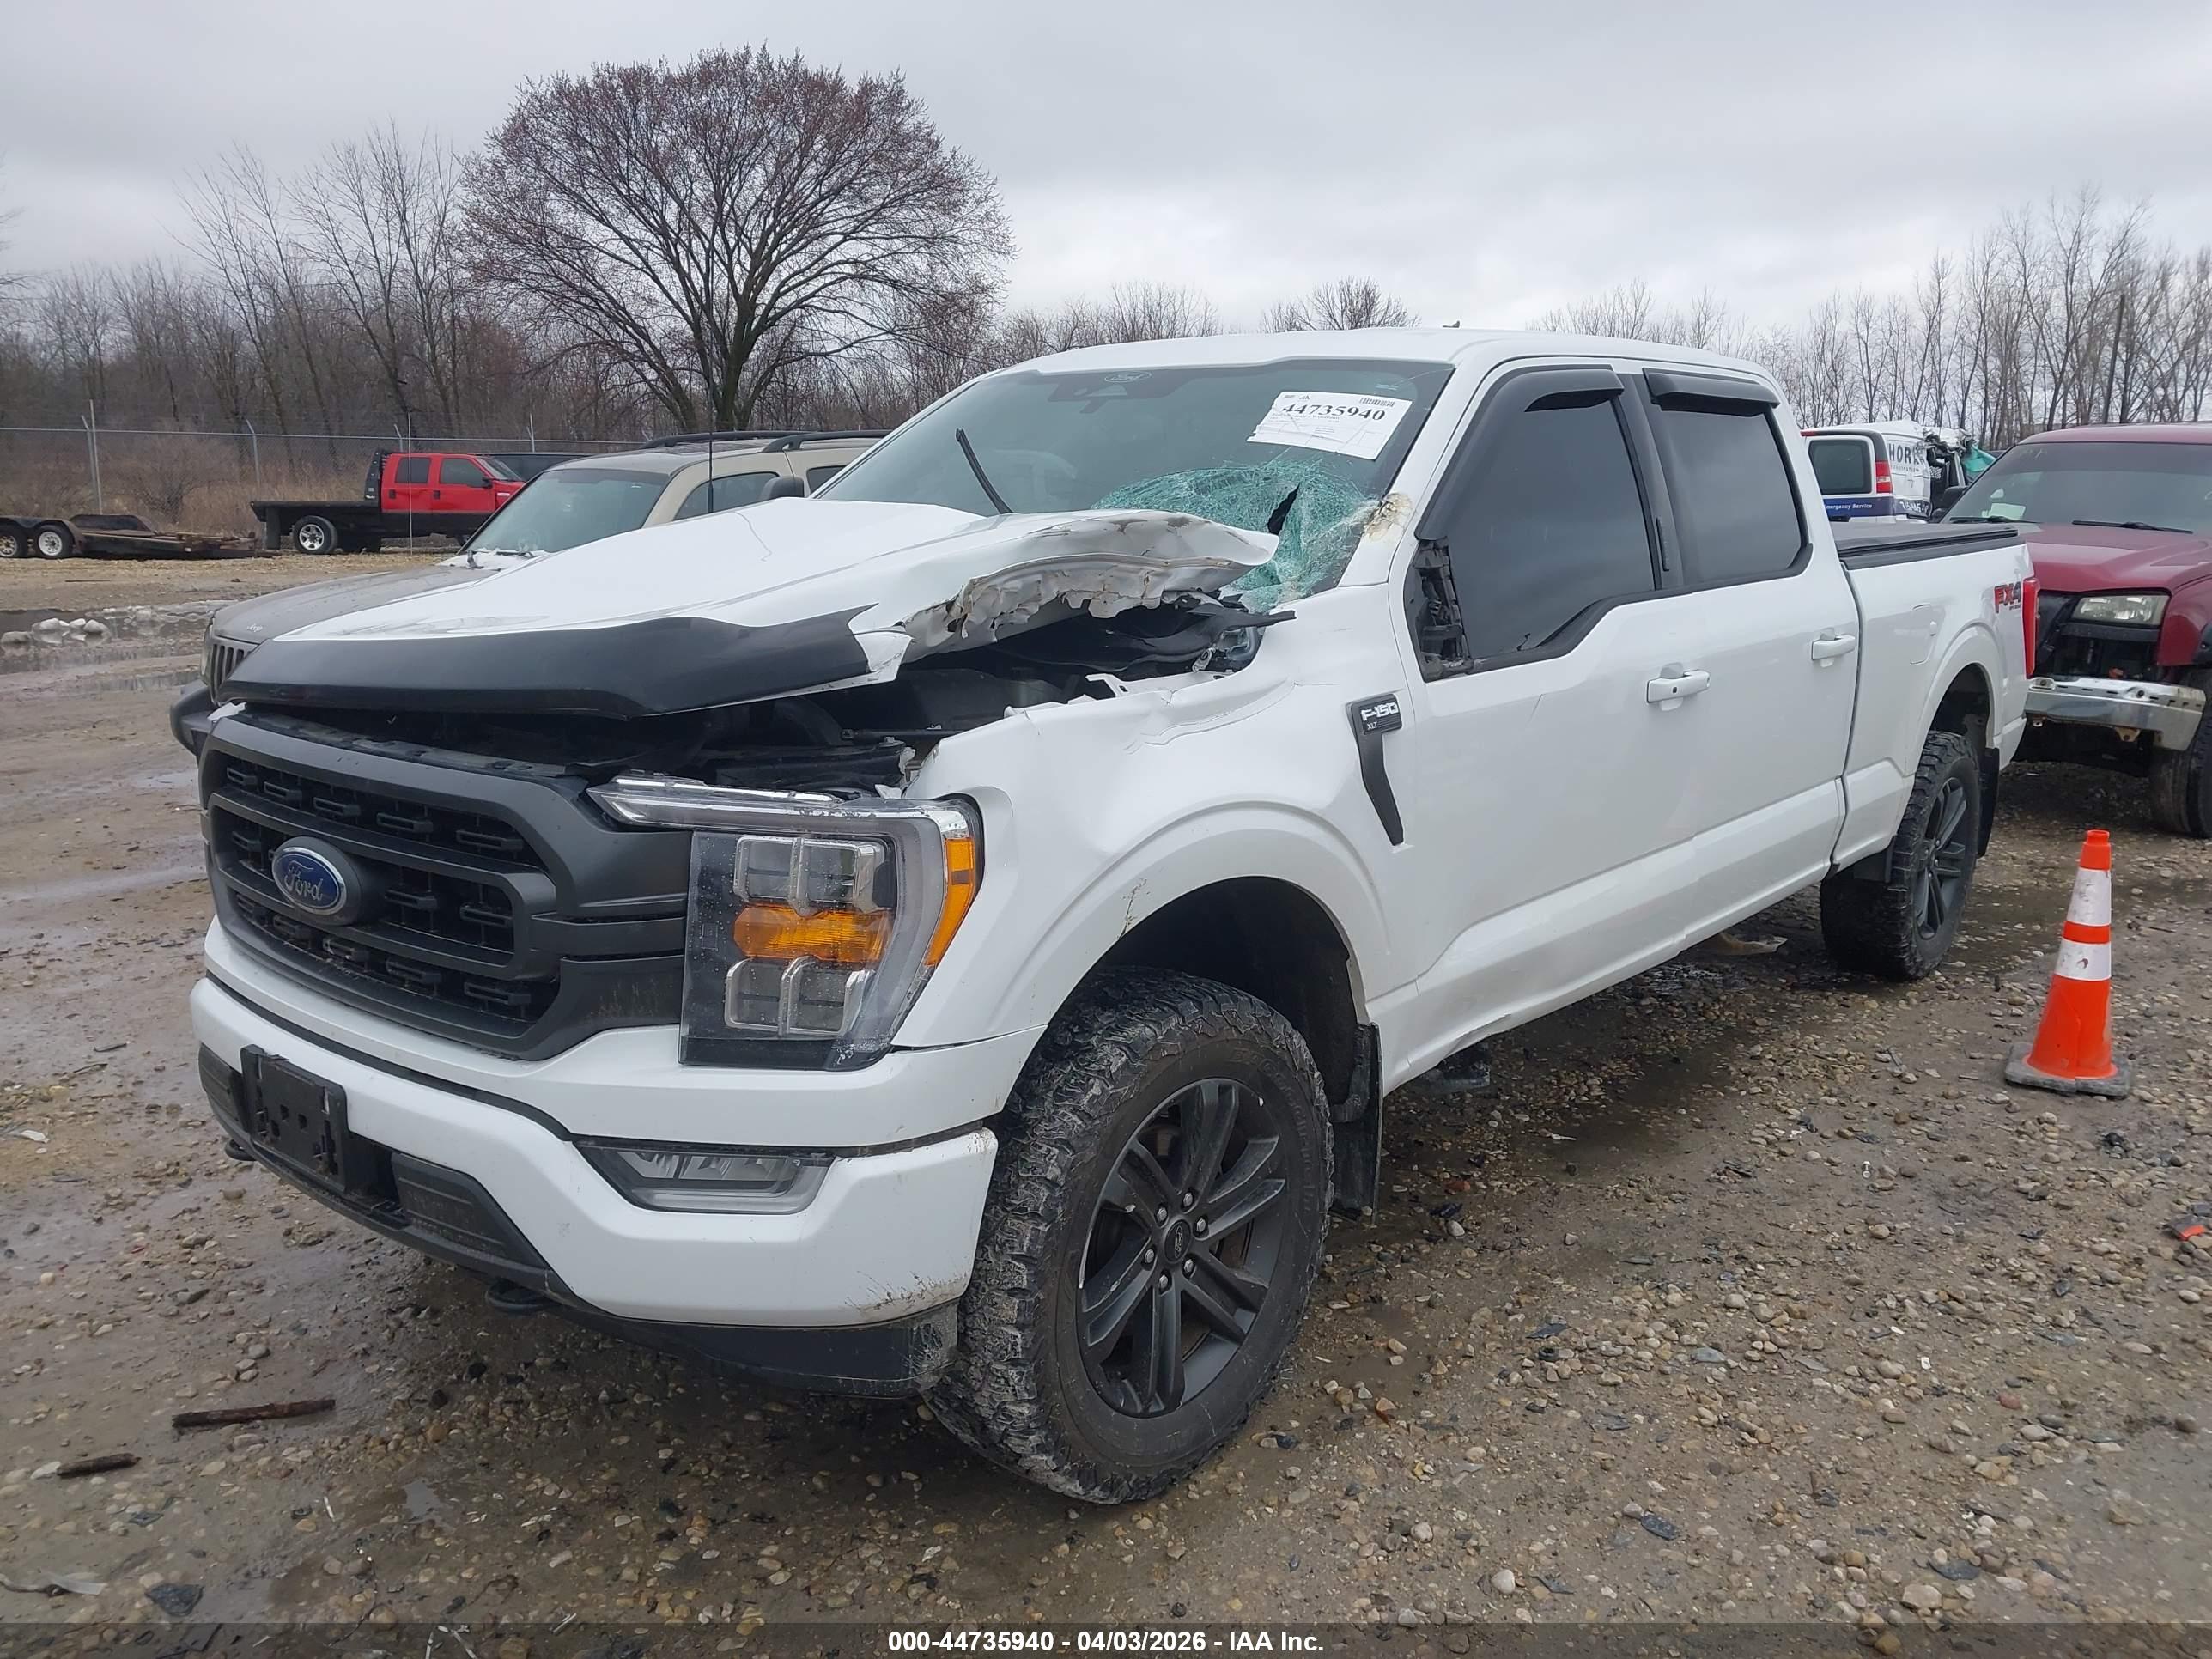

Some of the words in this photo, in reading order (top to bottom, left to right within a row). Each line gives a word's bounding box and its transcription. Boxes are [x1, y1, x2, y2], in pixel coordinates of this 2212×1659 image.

[1282, 404, 1385, 421] 44735940
[1994, 581, 2021, 614] FX4
[1360, 702, 1399, 721] F-150
[1367, 721, 1378, 730] XLT
[283, 860, 324, 902] Ford
